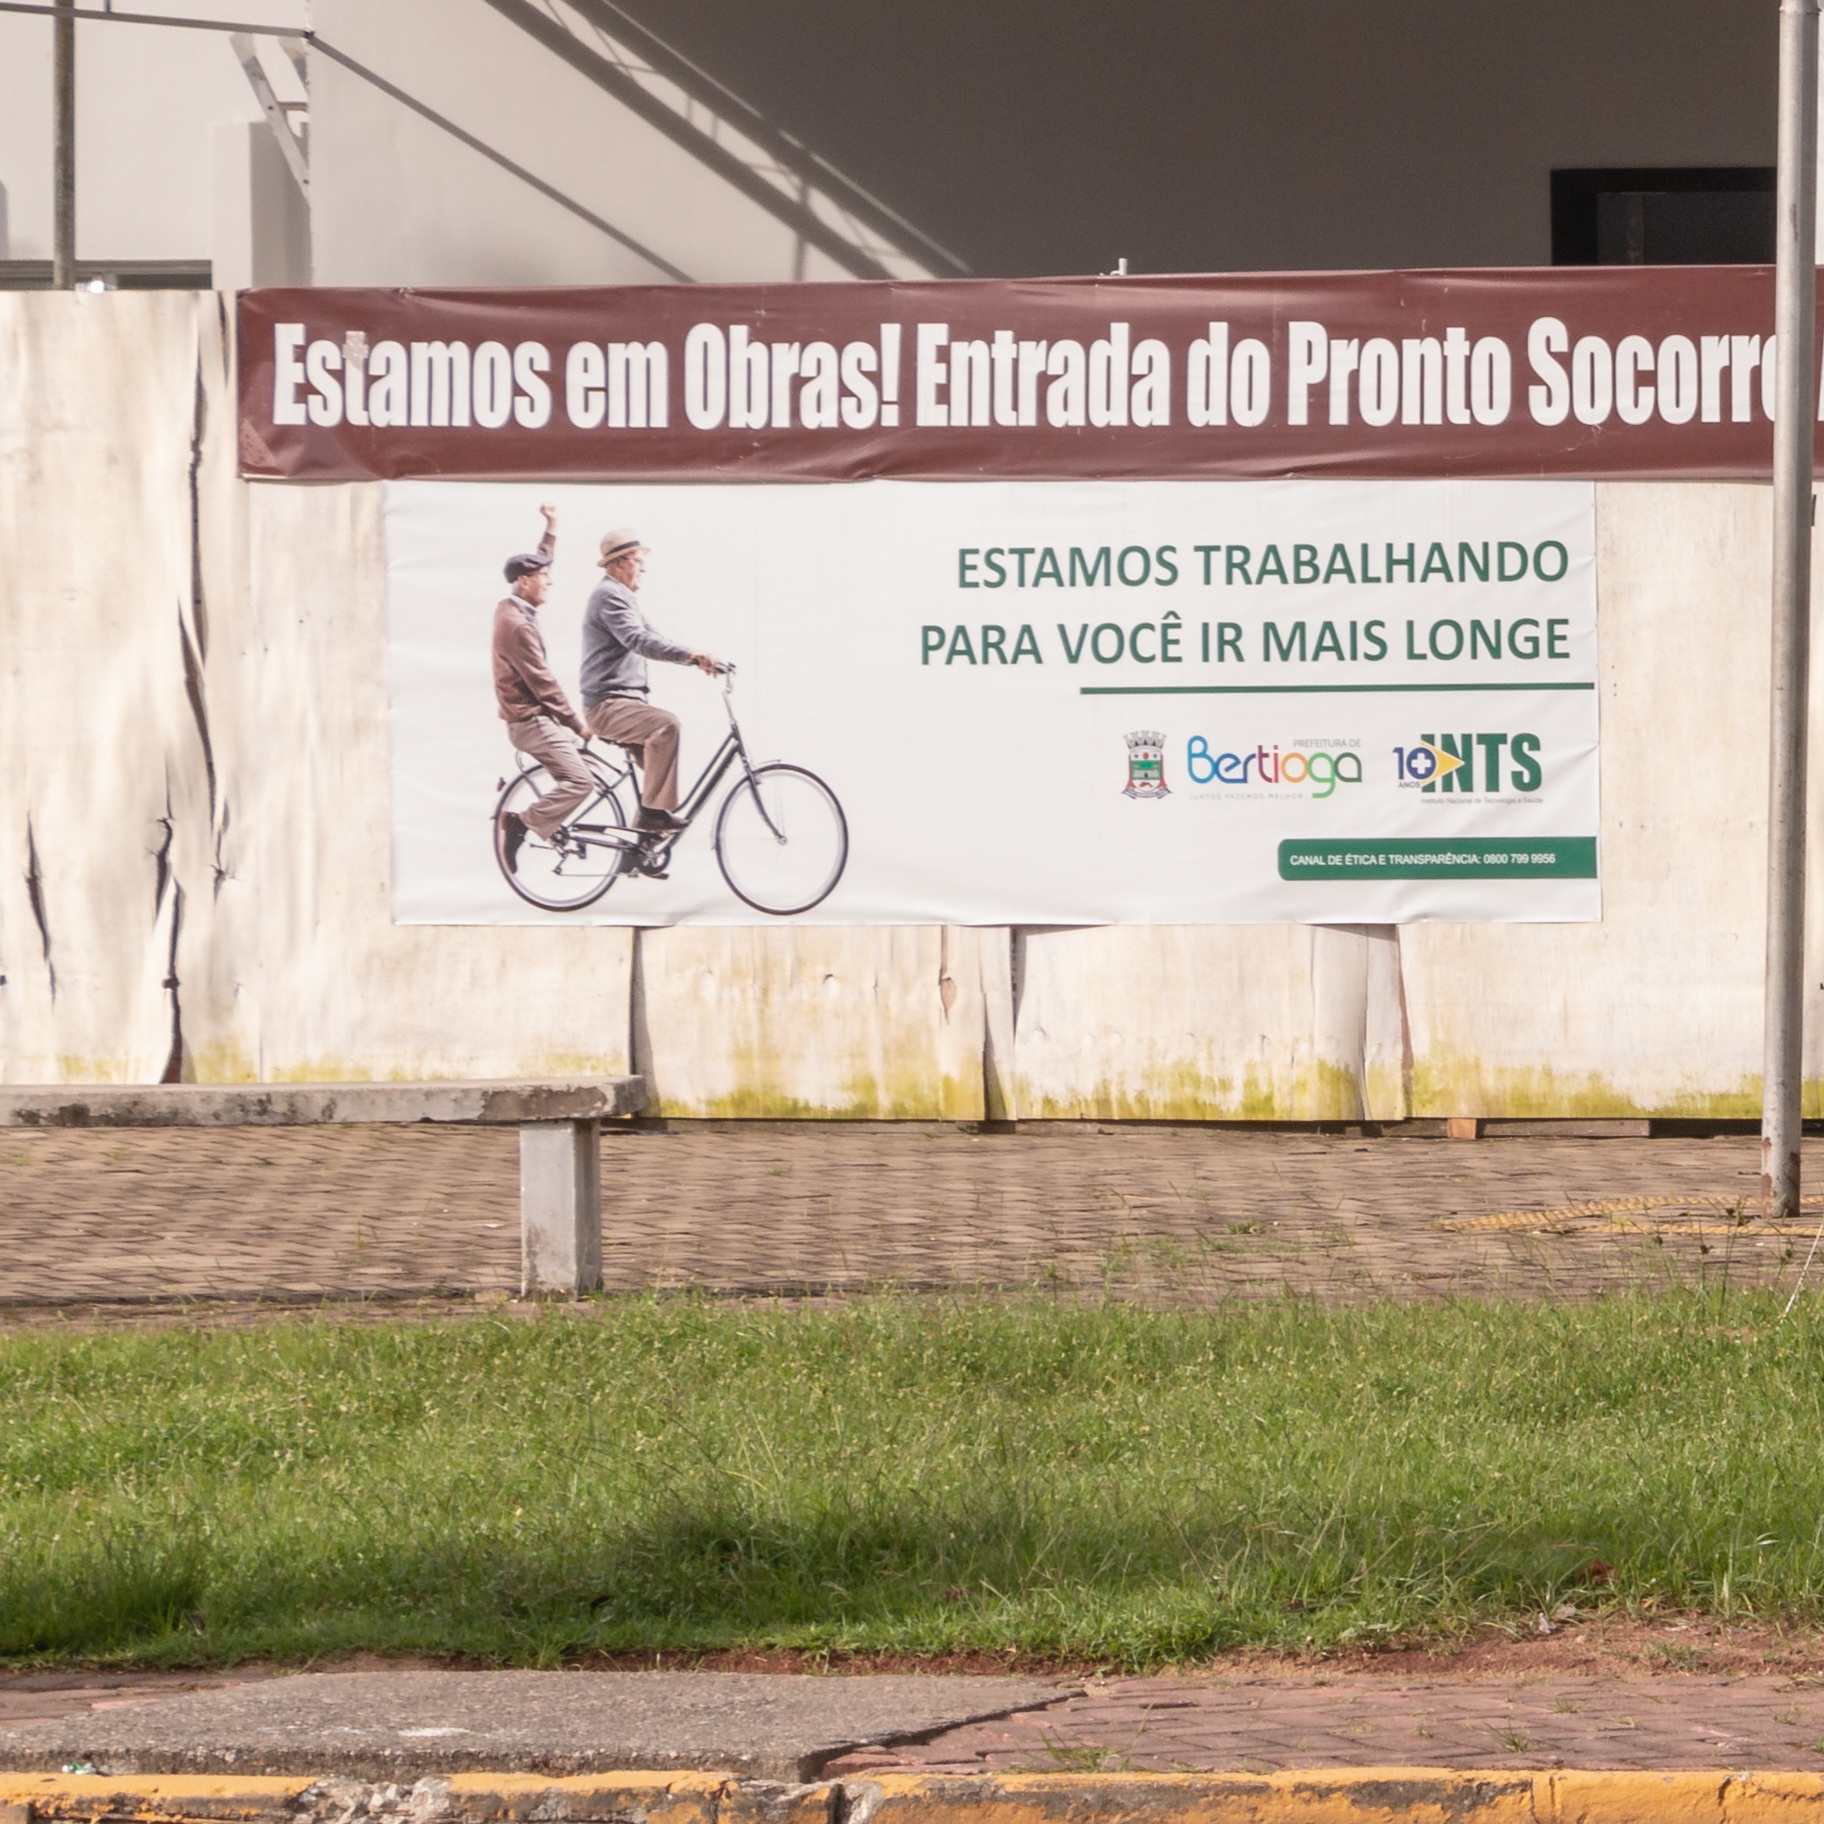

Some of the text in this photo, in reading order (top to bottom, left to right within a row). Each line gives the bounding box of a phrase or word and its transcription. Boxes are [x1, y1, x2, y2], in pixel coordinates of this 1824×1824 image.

[273, 323, 551, 429] Estamos
[565, 340, 668, 430] em
[684, 322, 901, 431] Obras!
[916, 322, 1170, 428] Entrada
[1187, 321, 1270, 428] do
[1288, 320, 1511, 427] Pronto
[957, 541, 1569, 589] ESTAMOS TRABALHANDO
[921, 610, 1570, 665] PARA VOCÊ IR MAIS LONGE
[1187, 735, 1362, 798] Bertioga
[1293, 739, 1361, 748] PREFEITURA DE
[1420, 733, 1542, 792] INTS
[1398, 781, 1421, 789] ANOS
[1484, 797, 1516, 805] Tecnologia
[1290, 855, 1325, 865] CANAL
[1327, 855, 1343, 865] DE
[1345, 853, 1378, 865] ÉTICA
[1379, 855, 1386, 865] E
[1389, 852, 1481, 865] TRANSPARÊNCIA:
[1483, 854, 1508, 864] 0800
[1510, 854, 1529, 864] 799
